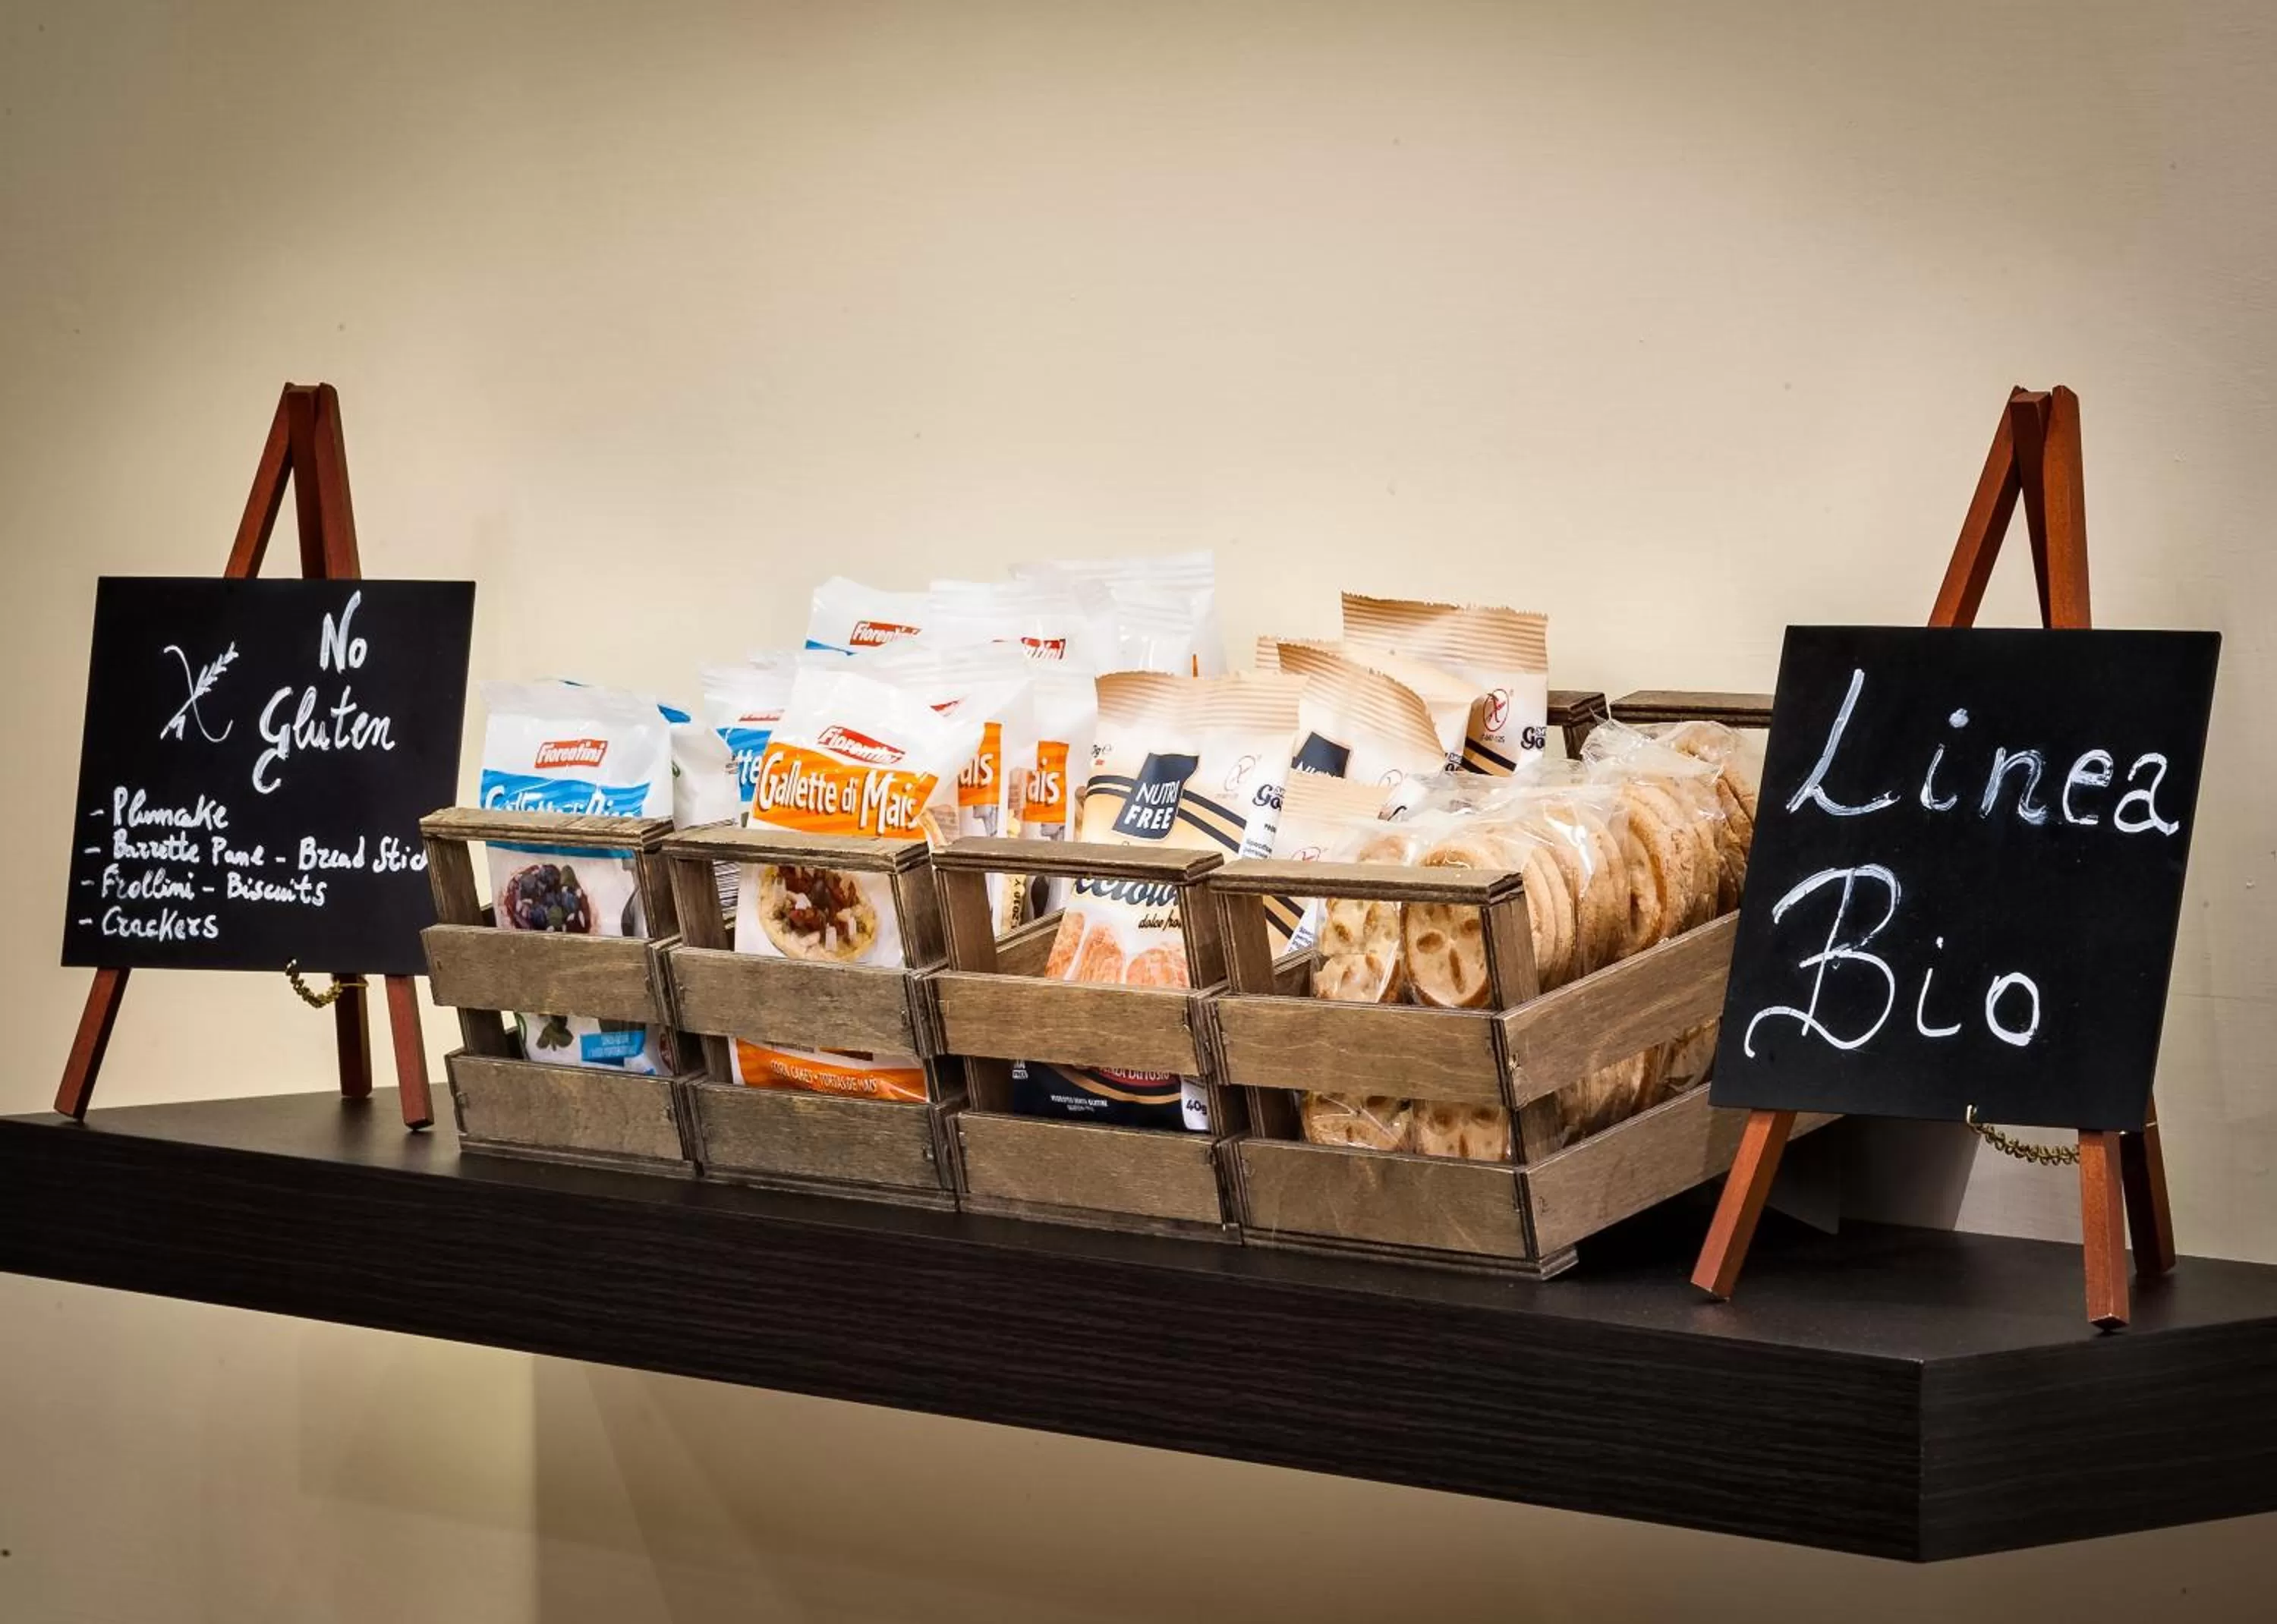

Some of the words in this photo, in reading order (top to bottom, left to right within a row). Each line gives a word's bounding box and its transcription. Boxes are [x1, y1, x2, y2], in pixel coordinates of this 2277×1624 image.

[320, 590, 367, 672] No
[252, 685, 395, 794] Gluten
[537, 741, 606, 764] Fiorentini
[1786, 668, 2179, 836] Linea
[758, 751, 837, 814] Gallette
[842, 776, 858, 814] di
[859, 768, 918, 835] Mais
[1135, 780, 1180, 805] NUTRI
[1124, 804, 1174, 829] FREE
[211, 836, 265, 867] Pane
[298, 835, 366, 871] Bread
[101, 863, 195, 901] Frollini
[227, 871, 328, 907] Biscuits
[101, 905, 219, 943] Crackers
[1138, 913, 1163, 930] dolce
[1743, 863, 2040, 1058] Bio
